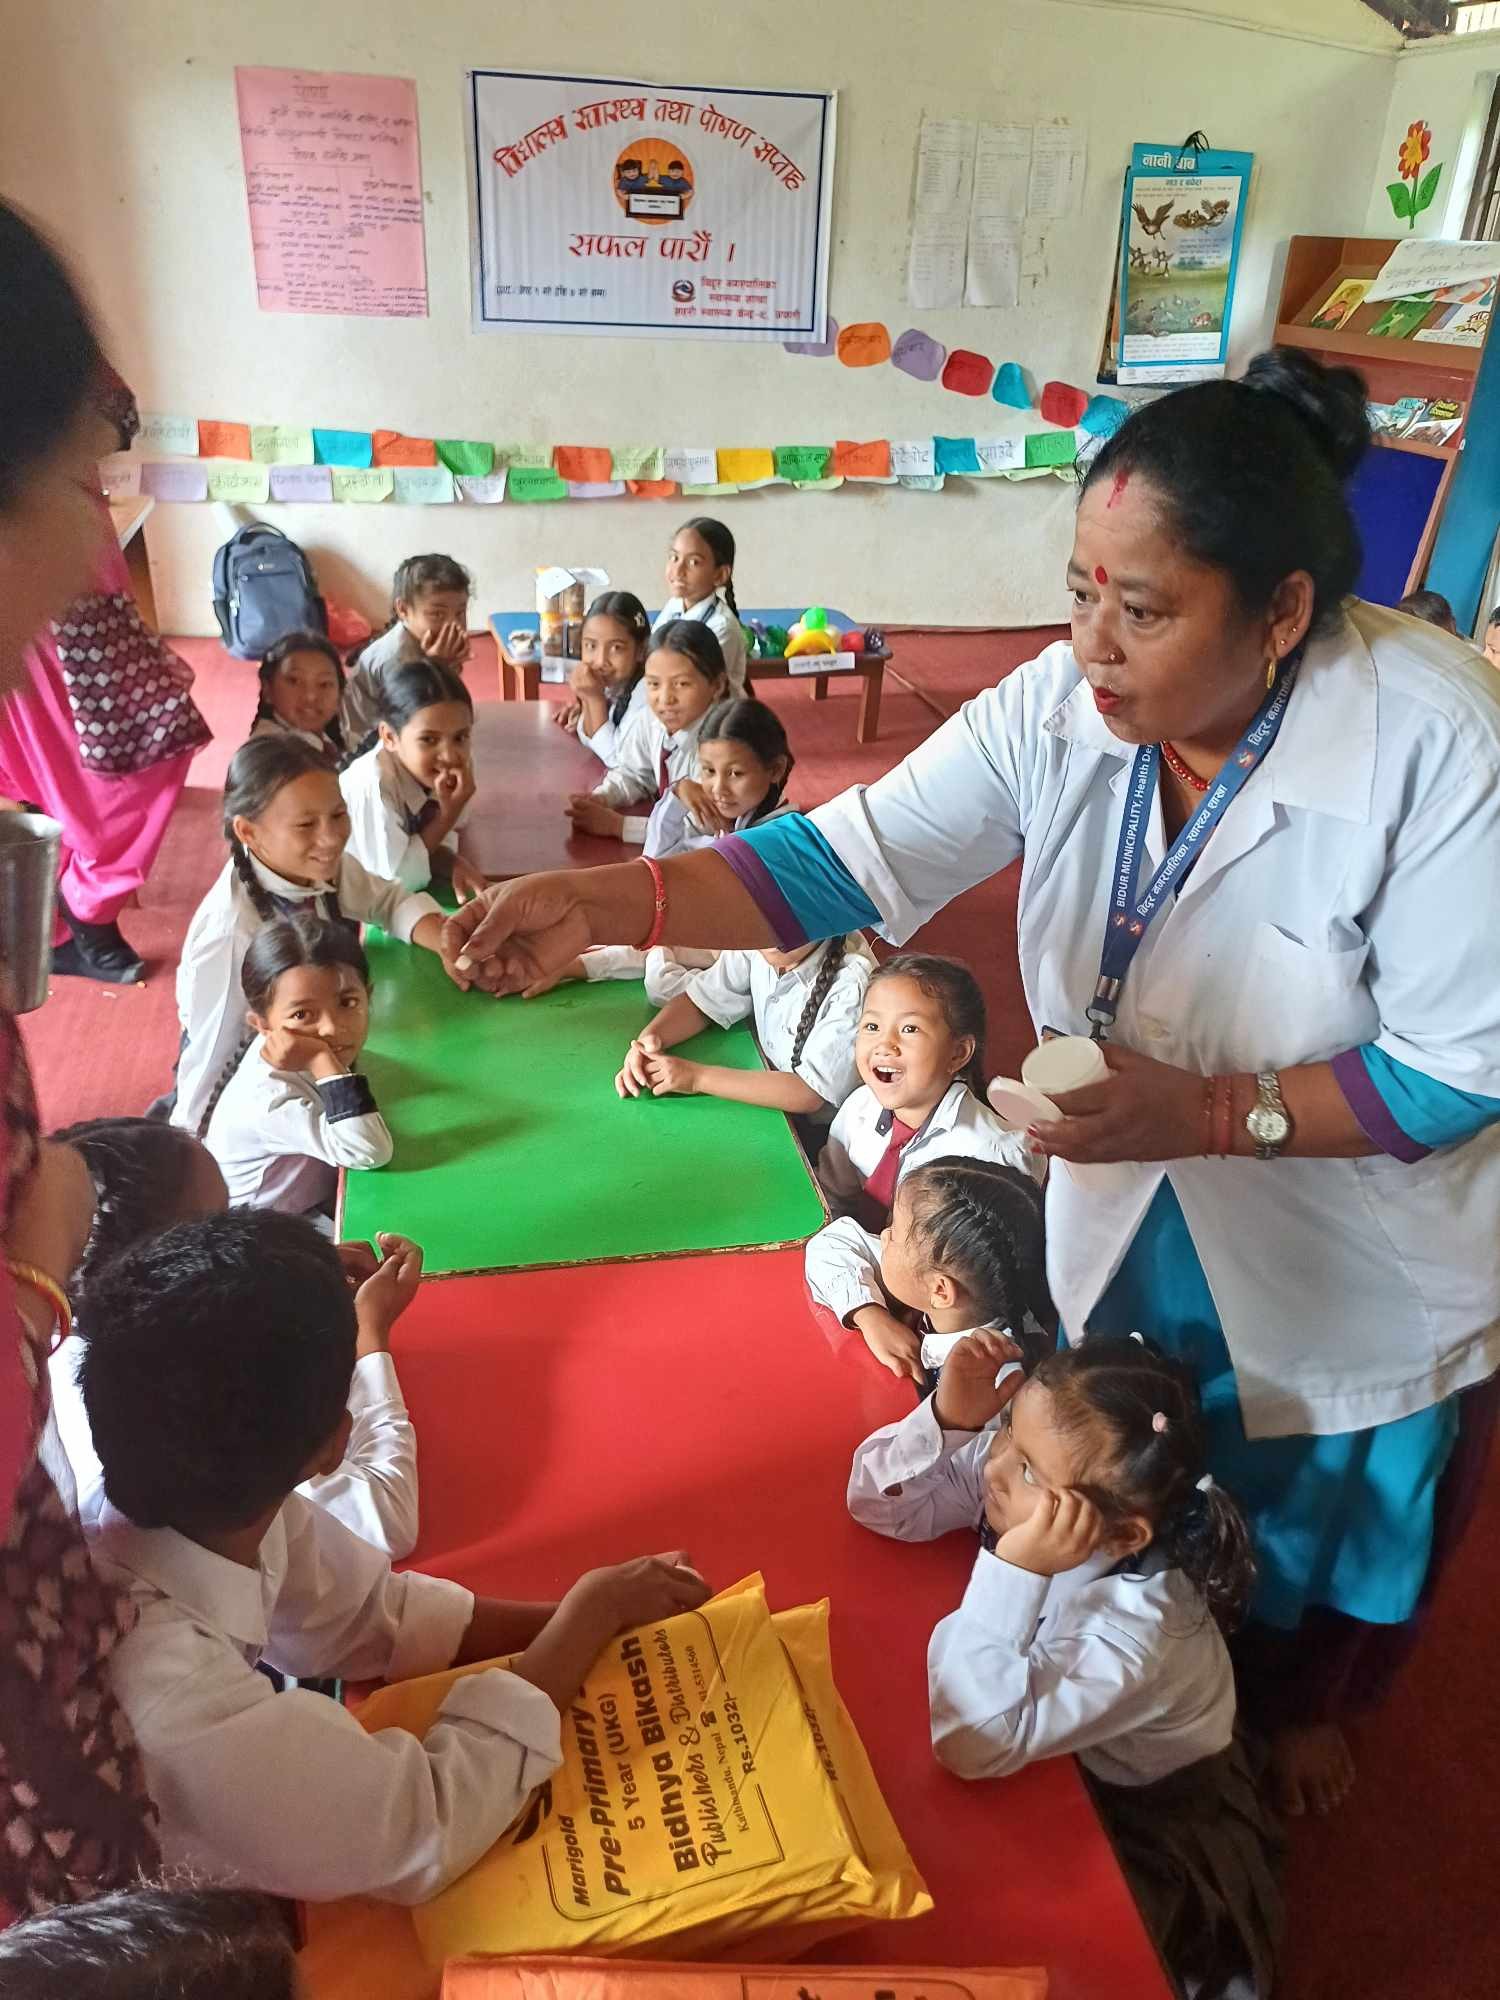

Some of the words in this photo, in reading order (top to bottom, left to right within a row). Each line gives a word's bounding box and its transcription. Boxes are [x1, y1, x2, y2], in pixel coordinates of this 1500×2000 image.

[654, 98, 695, 125] तथा
[699, 104, 757, 148] पोषण
[754, 136, 806, 191] सप्ताह
[1142, 152, 1172, 168] नानी
[569, 233, 649, 258] सफल
[1134, 766, 1150, 799] Health
[1186, 809, 1212, 843] स्वास्थ्य
[1208, 784, 1228, 811] शाखा
[1120, 799, 1145, 874] MUNICIPALITY,
[1116, 874, 1130, 908] BIDUR
[620, 1636, 667, 1747] Bikash
[652, 1628, 692, 1726] Distributors
[597, 1692, 631, 1755] (UKG)
[678, 1725, 701, 1747] &
[711, 1731, 728, 1765] Nepal
[723, 1691, 757, 1776] Rs.1032/-
[571, 1704, 632, 1897] Pre-Primary
[617, 1762, 641, 1811] Year
[651, 1750, 700, 1873] Bidhya
[686, 1752, 733, 1867] Publishers
[723, 1767, 750, 1833] Kathmandu,
[627, 1815, 646, 1832] 5
[558, 1813, 591, 1907] Marigold
